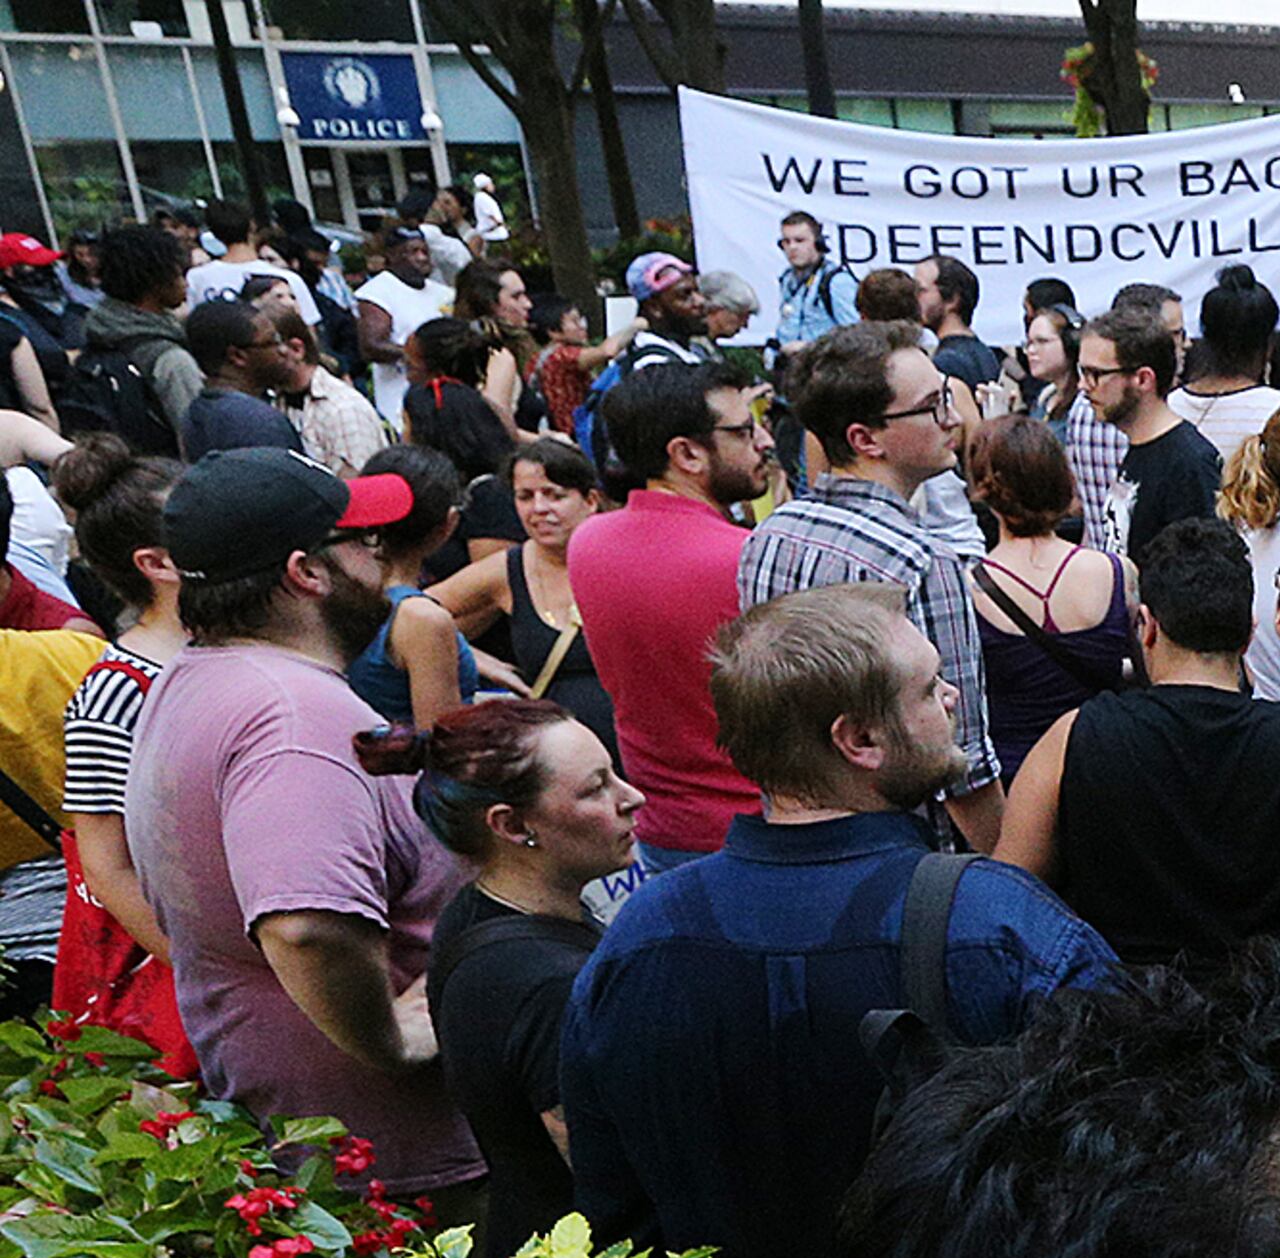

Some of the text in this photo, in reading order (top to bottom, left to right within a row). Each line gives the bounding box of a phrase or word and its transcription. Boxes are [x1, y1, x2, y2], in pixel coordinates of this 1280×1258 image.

[312, 119, 411, 138] POLICE
[761, 153, 870, 196] WE
[904, 165, 1028, 199] GOT
[1062, 164, 1146, 198] UR
